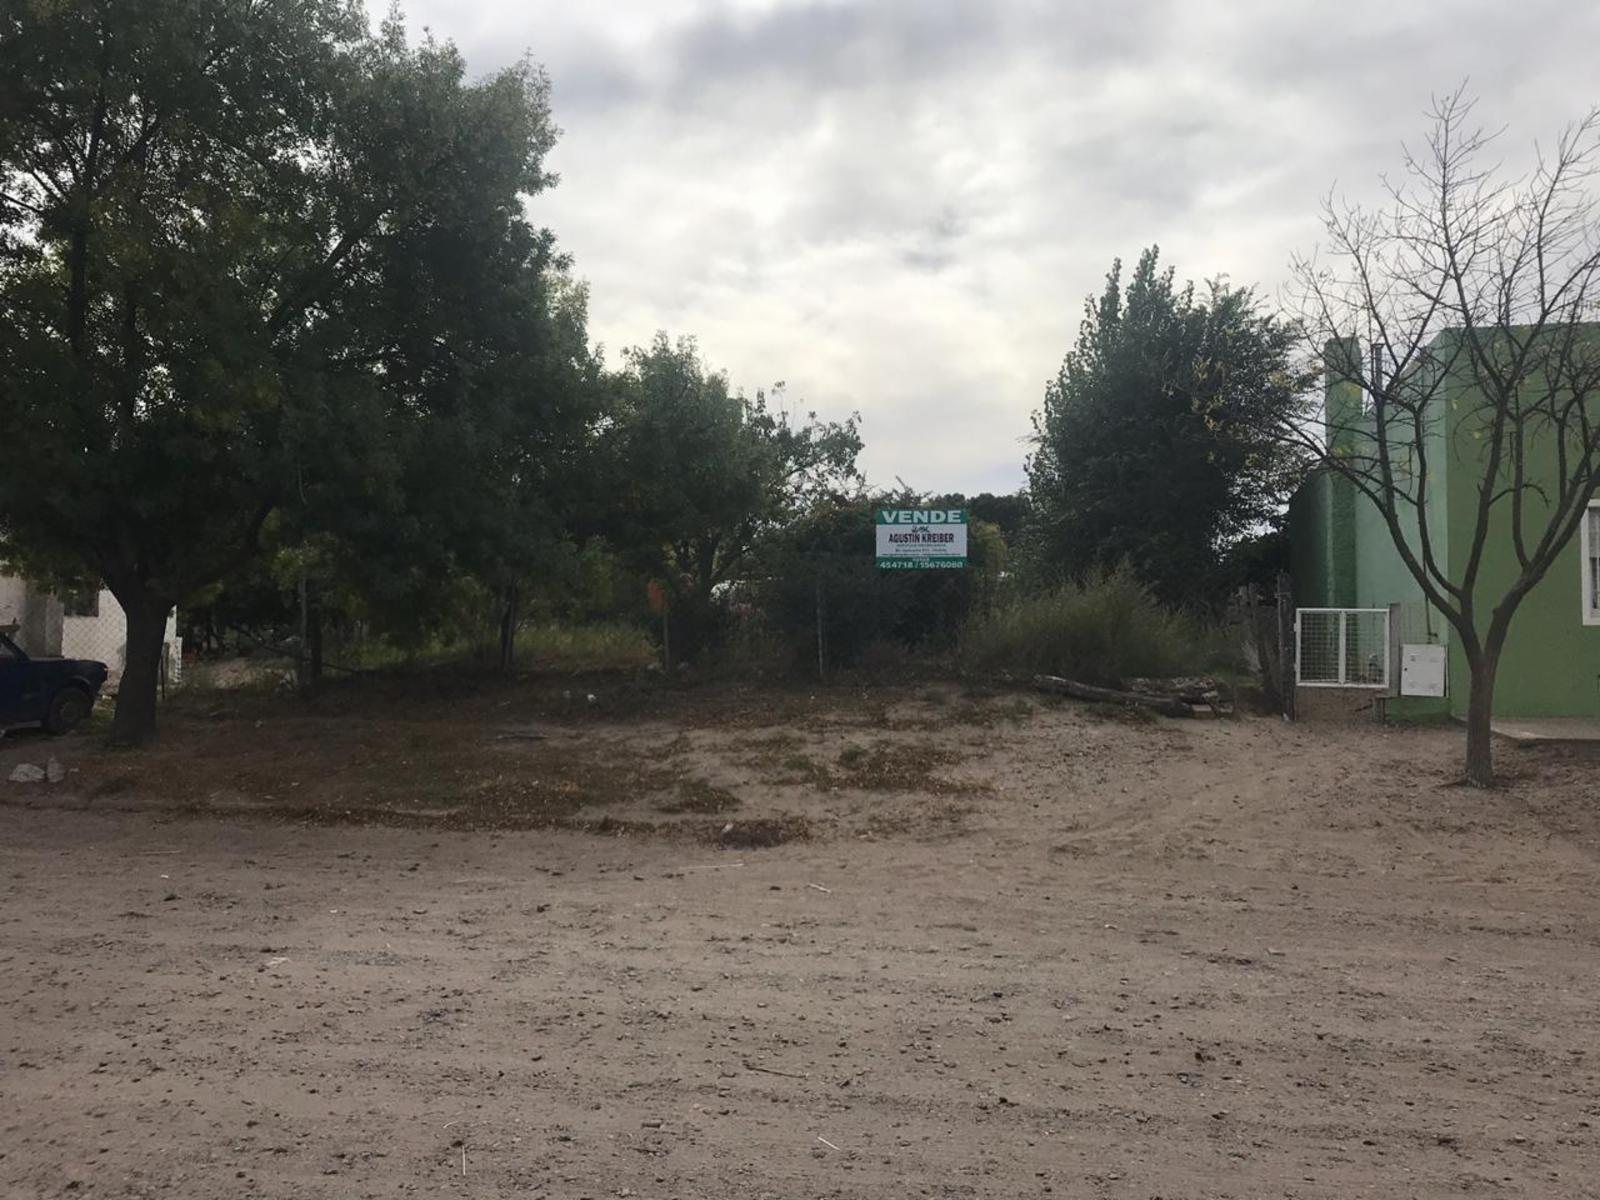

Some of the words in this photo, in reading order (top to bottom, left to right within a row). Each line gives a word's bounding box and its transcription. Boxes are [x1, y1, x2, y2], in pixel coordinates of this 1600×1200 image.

[882, 510, 961, 523] VENDE
[888, 533, 920, 543] AGUSTIN
[921, 533, 955, 543] KREIBER
